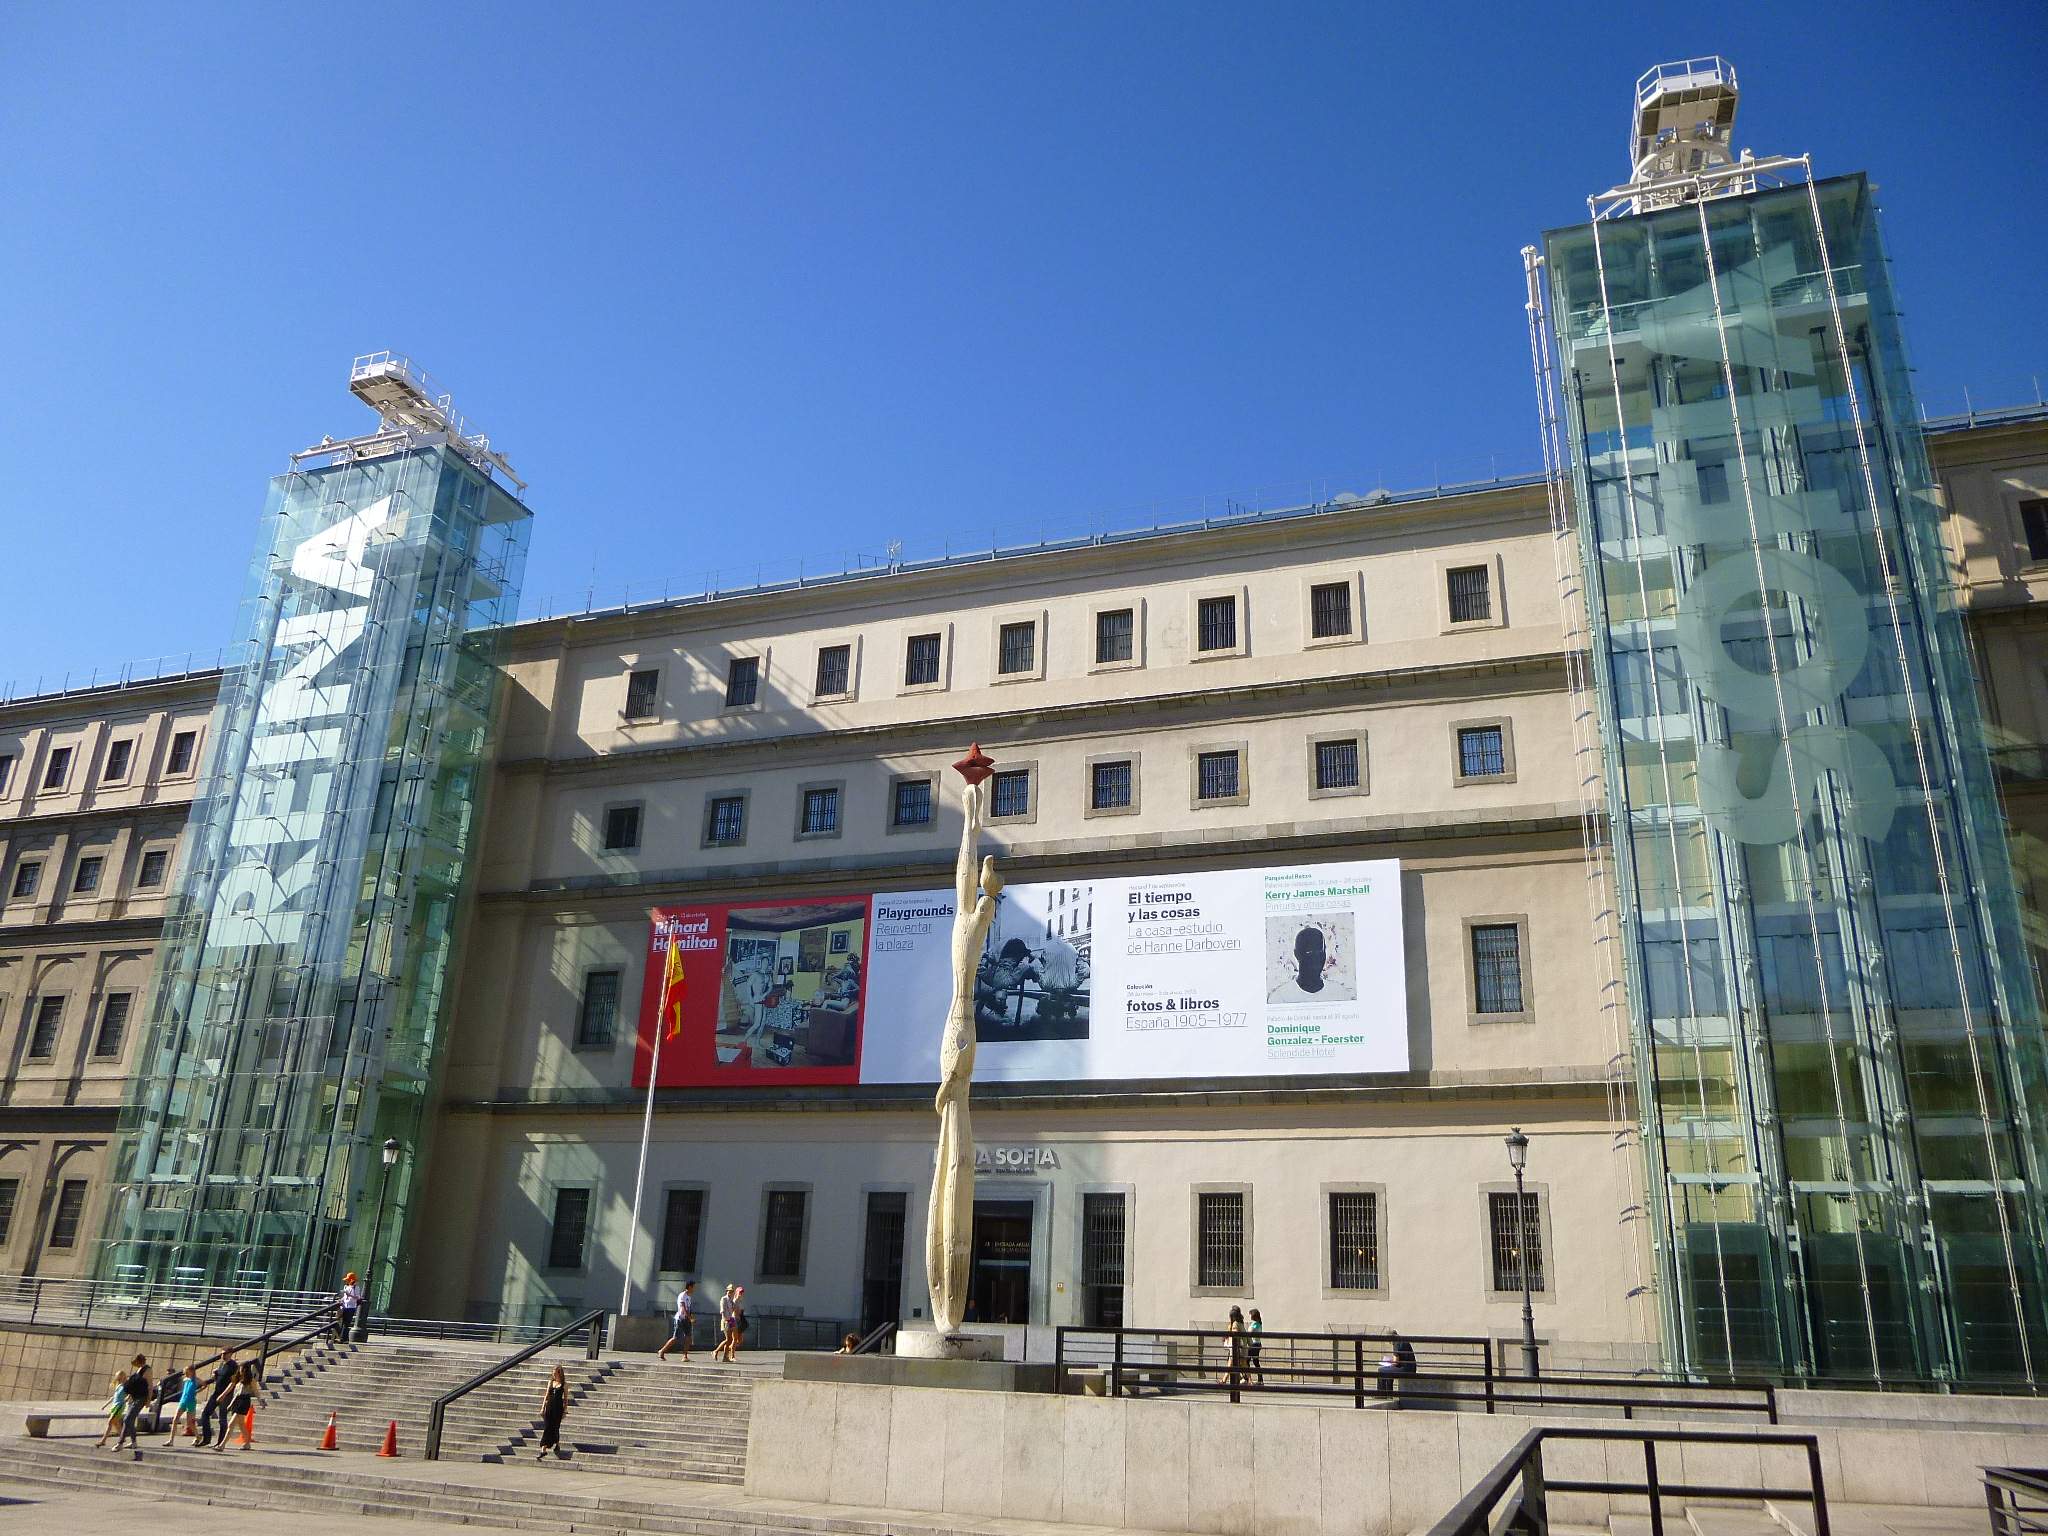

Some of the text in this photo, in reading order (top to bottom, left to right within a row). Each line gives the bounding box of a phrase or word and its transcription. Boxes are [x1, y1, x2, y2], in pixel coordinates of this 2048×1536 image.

[1637, 241, 1896, 845] SOFIA
[206, 494, 392, 948] REINA
[1128, 891, 1192, 905] El tiempo
[1265, 891, 1291, 900] Kerry
[1293, 889, 1325, 898] James
[1327, 885, 1370, 896] Marshall
[877, 904, 954, 921] Playgrounds
[1128, 908, 1200, 923] y las cosas
[876, 921, 932, 935] Reinventar
[1128, 921, 1223, 938] La casa-estudio
[875, 937, 914, 951] la plaza
[1127, 937, 1241, 954] de Hanne Darboven
[1126, 997, 1220, 1012] fotos & libros
[1126, 1015, 1170, 1029] España
[1267, 1024, 1321, 1034] Dominique
[1267, 1036, 1313, 1046] Gonzalez
[1321, 1034, 1365, 1044] Foerster
[995, 1147, 1056, 1165] SOFIA
